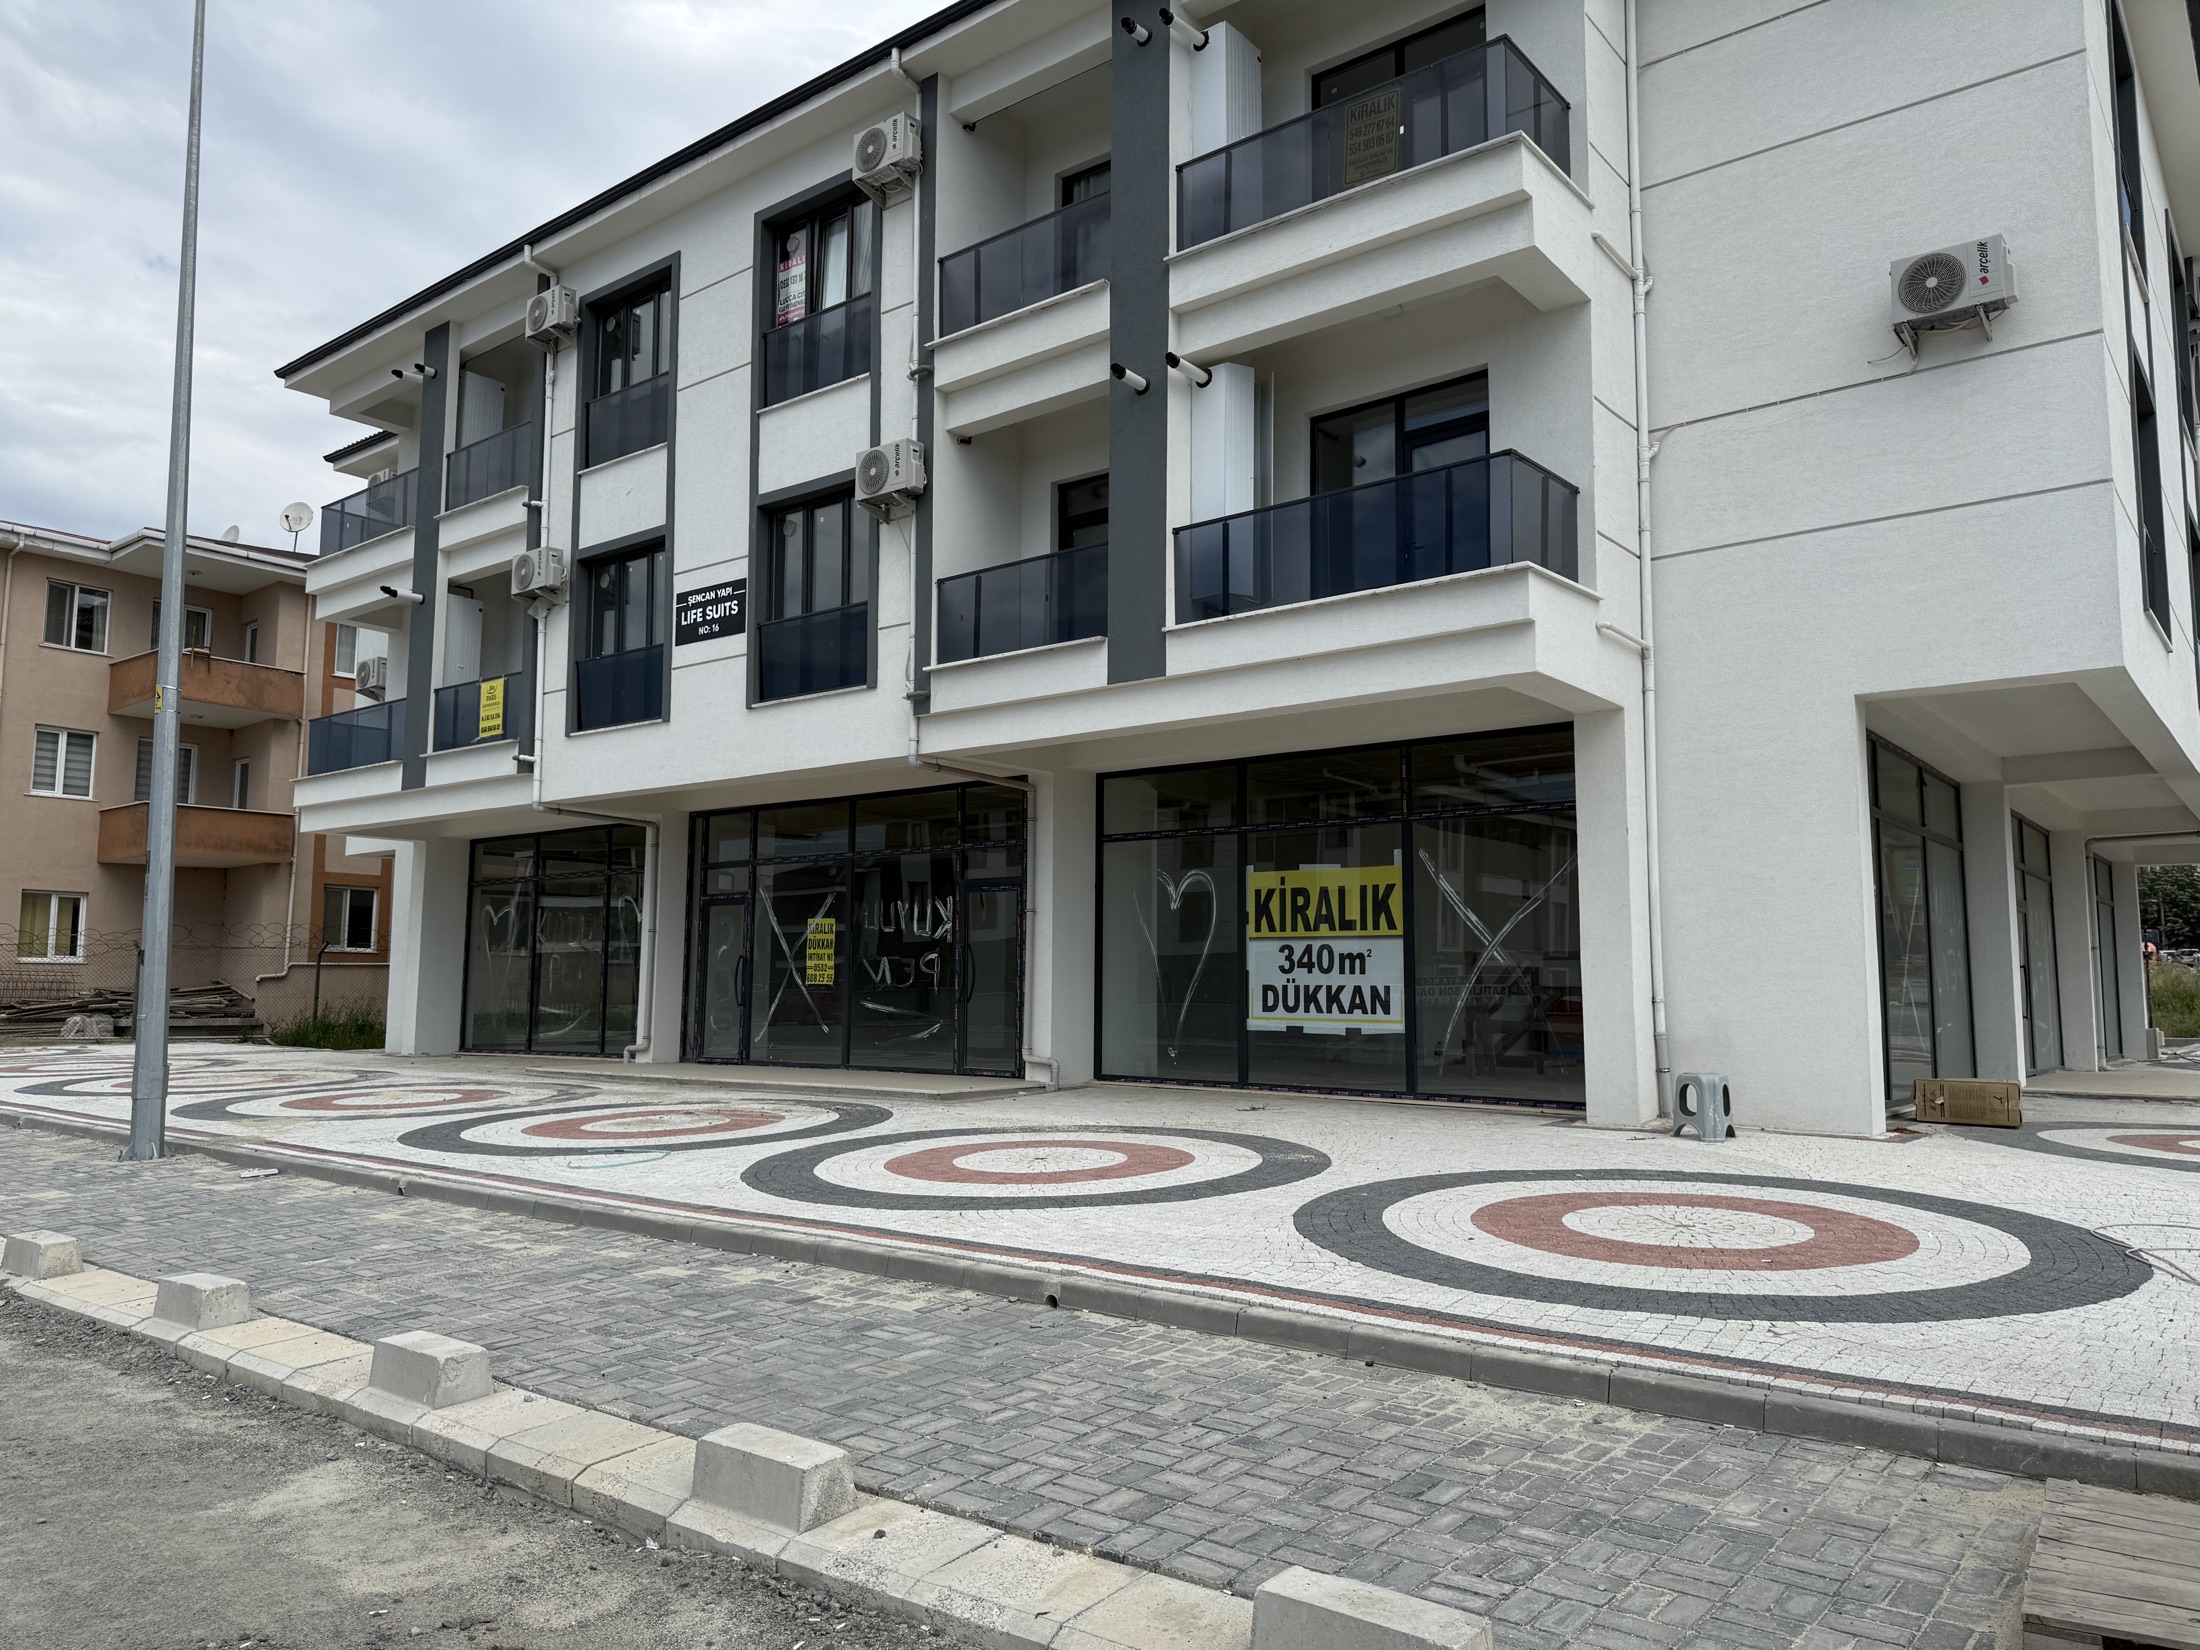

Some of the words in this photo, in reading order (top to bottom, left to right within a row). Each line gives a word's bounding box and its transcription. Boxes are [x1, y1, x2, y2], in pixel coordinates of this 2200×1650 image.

[1363, 121, 1376, 136] 277
[1376, 118, 1386, 132] 67
[1362, 137, 1375, 152] 503
[1376, 133, 1385, 148] 05
[1386, 131, 1395, 145] 07
[1977, 241, 1991, 274] arçelik
[687, 590, 716, 607] ŞENCAN
[716, 586, 733, 598] YAPI
[681, 607, 703, 626] LIFE
[705, 600, 739, 620] SUITS
[698, 625, 711, 636] NO:
[711, 623, 720, 633] 16
[1254, 876, 1398, 933] KİRALIK
[807, 935, 834, 950] DÜKKAN
[1261, 977, 1391, 1016] DÜKKAN
